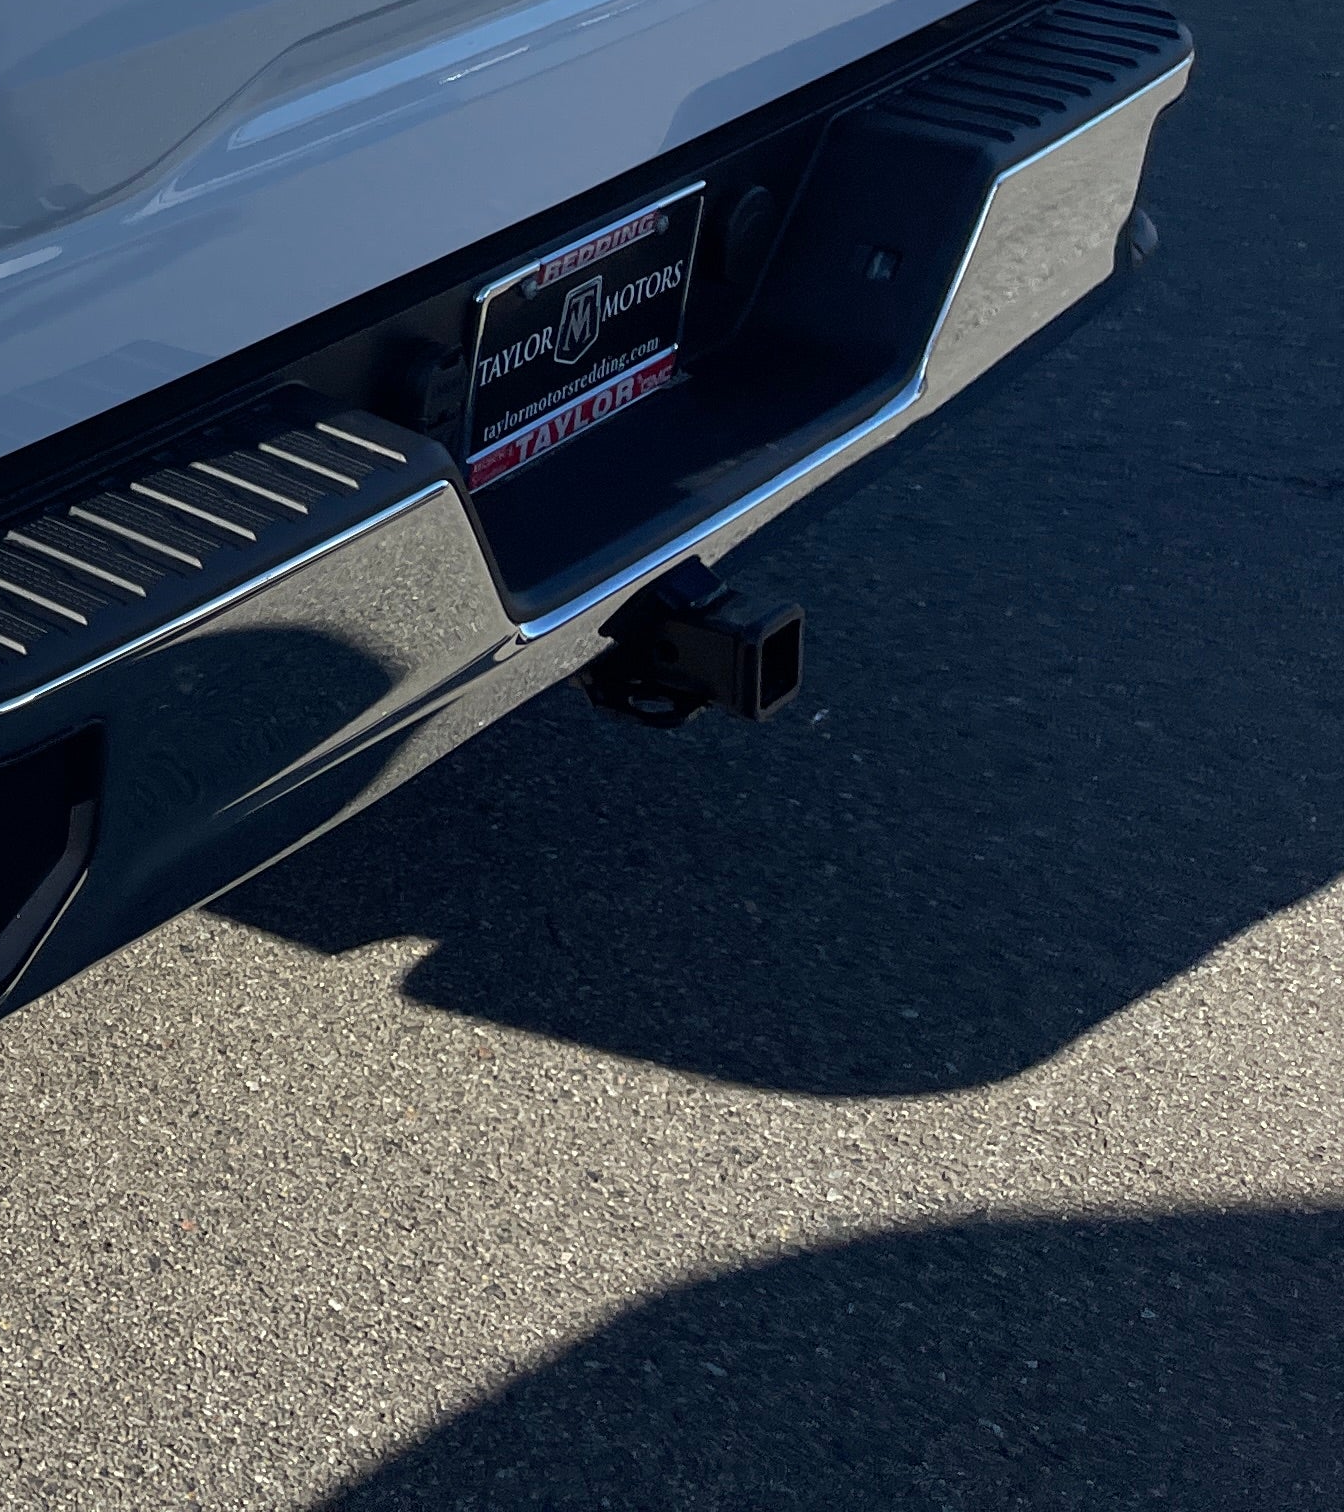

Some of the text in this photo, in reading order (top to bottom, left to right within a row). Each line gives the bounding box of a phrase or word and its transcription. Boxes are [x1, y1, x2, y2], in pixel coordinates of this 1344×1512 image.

[543, 212, 656, 283] REDDING
[478, 326, 554, 387] TAYLOR
[601, 260, 684, 322] MOTORS
[483, 337, 660, 442] taylormotorsredding.com
[515, 377, 636, 464] TAYLOR
